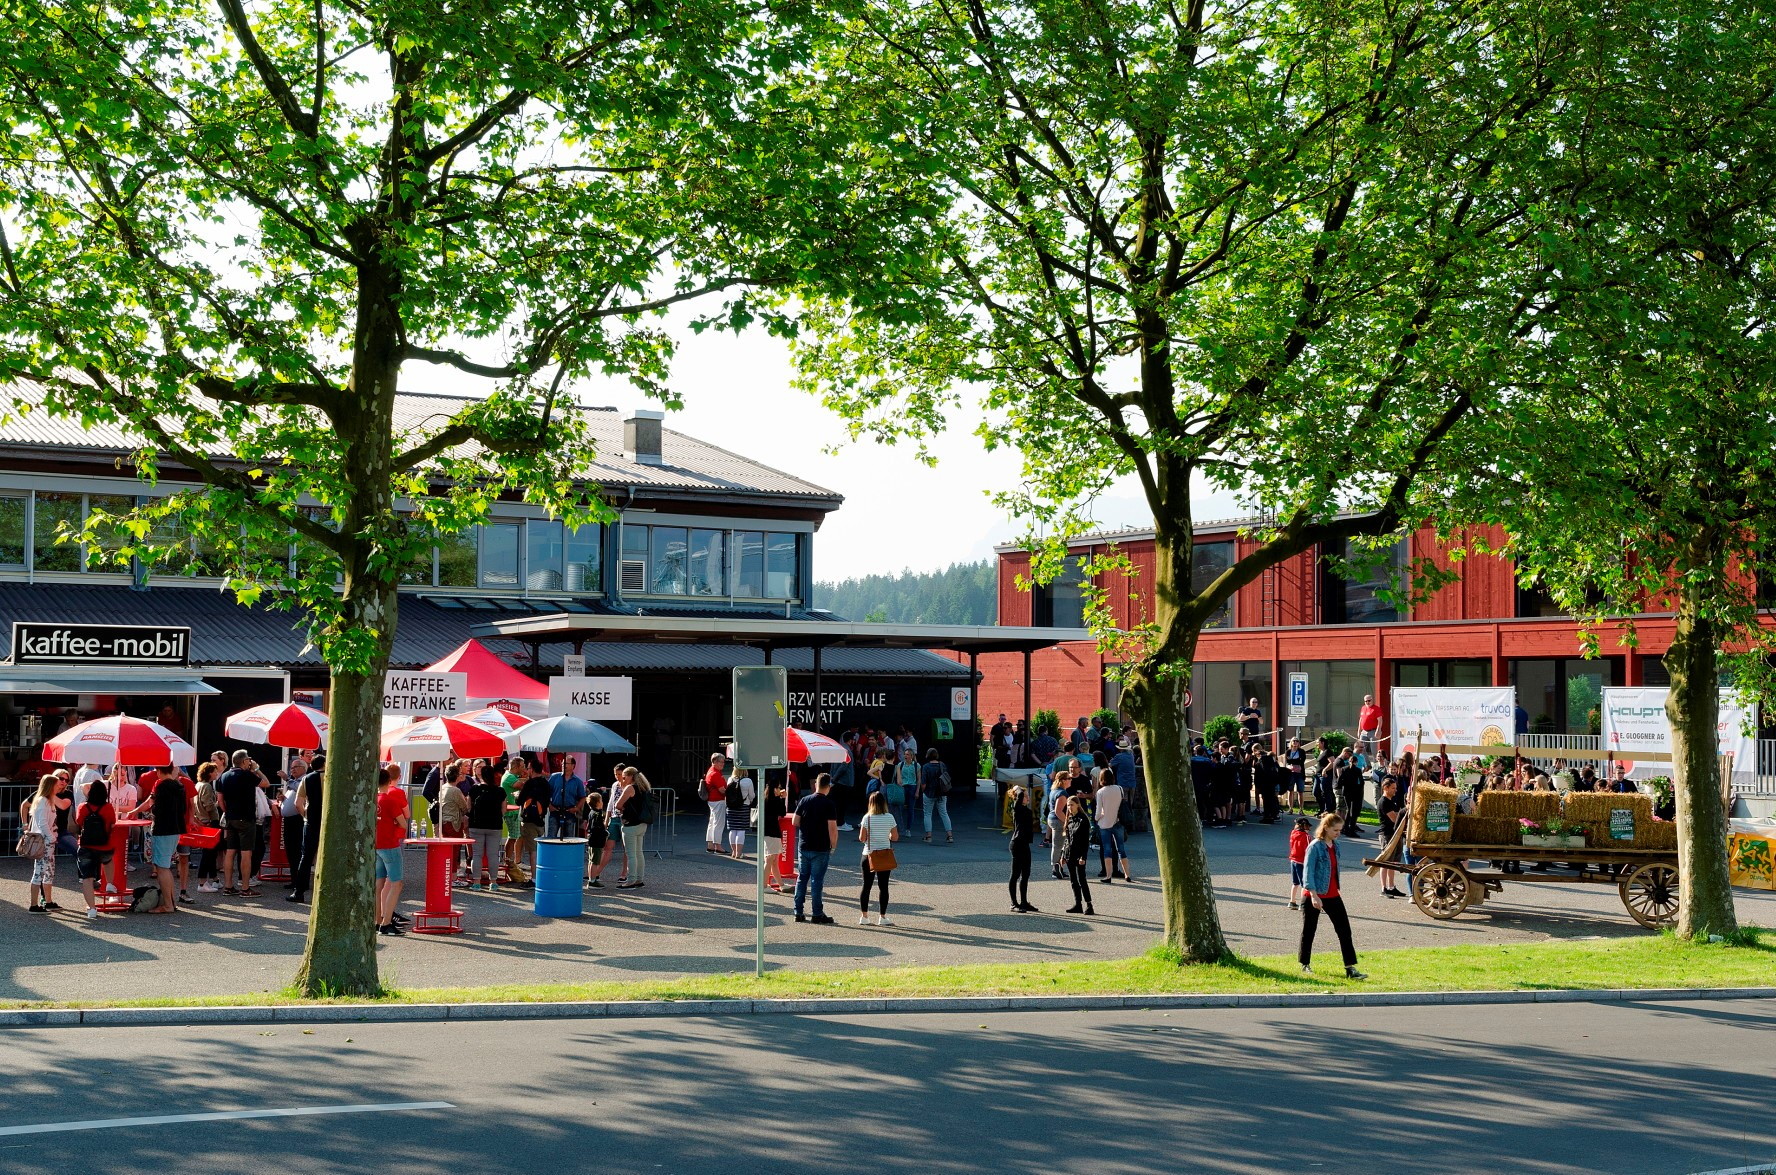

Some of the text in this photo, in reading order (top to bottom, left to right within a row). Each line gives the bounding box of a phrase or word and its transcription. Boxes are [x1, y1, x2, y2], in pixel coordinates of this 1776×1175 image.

[21, 628, 185, 657] kaffee-mobil
[391, 676, 450, 692] KAFFEE-
[1296, 682, 1302, 694] P
[383, 692, 457, 711] GETRÄNKE
[571, 691, 611, 705] KASSE
[488, 703, 519, 713] MSEIER
[1406, 708, 1432, 717] Krieger
[1480, 703, 1511, 717] truvag
[787, 709, 844, 724] ESMATT
